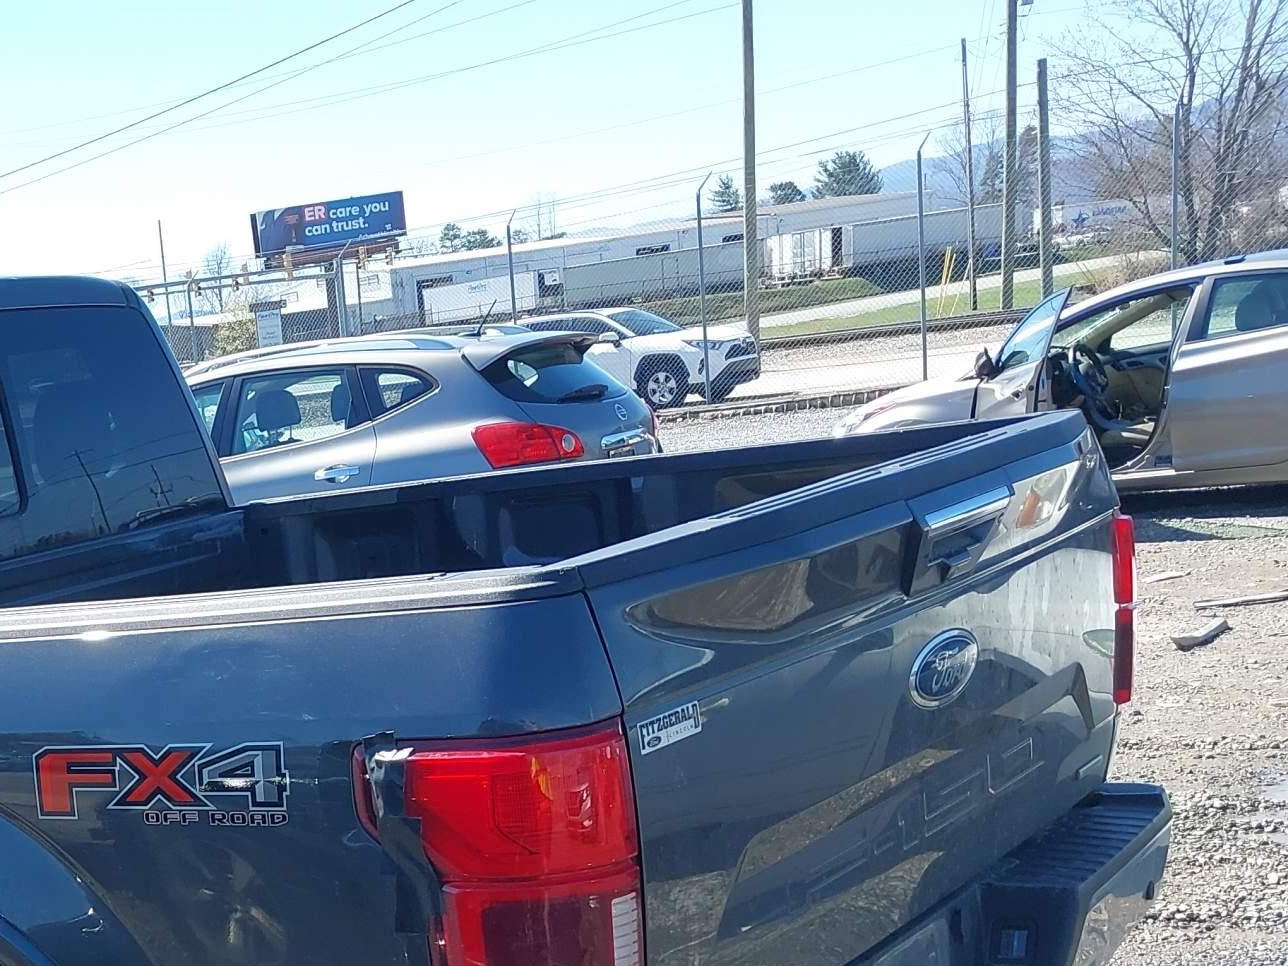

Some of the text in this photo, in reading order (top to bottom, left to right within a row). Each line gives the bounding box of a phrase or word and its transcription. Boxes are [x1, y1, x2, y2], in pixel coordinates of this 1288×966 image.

[304, 200, 390, 221] ER care you
[305, 216, 369, 236] can trust.
[637, 702, 701, 751] FITZGERALD
[33, 741, 290, 820] FX4
[143, 810, 289, 826] OFF ROAD
